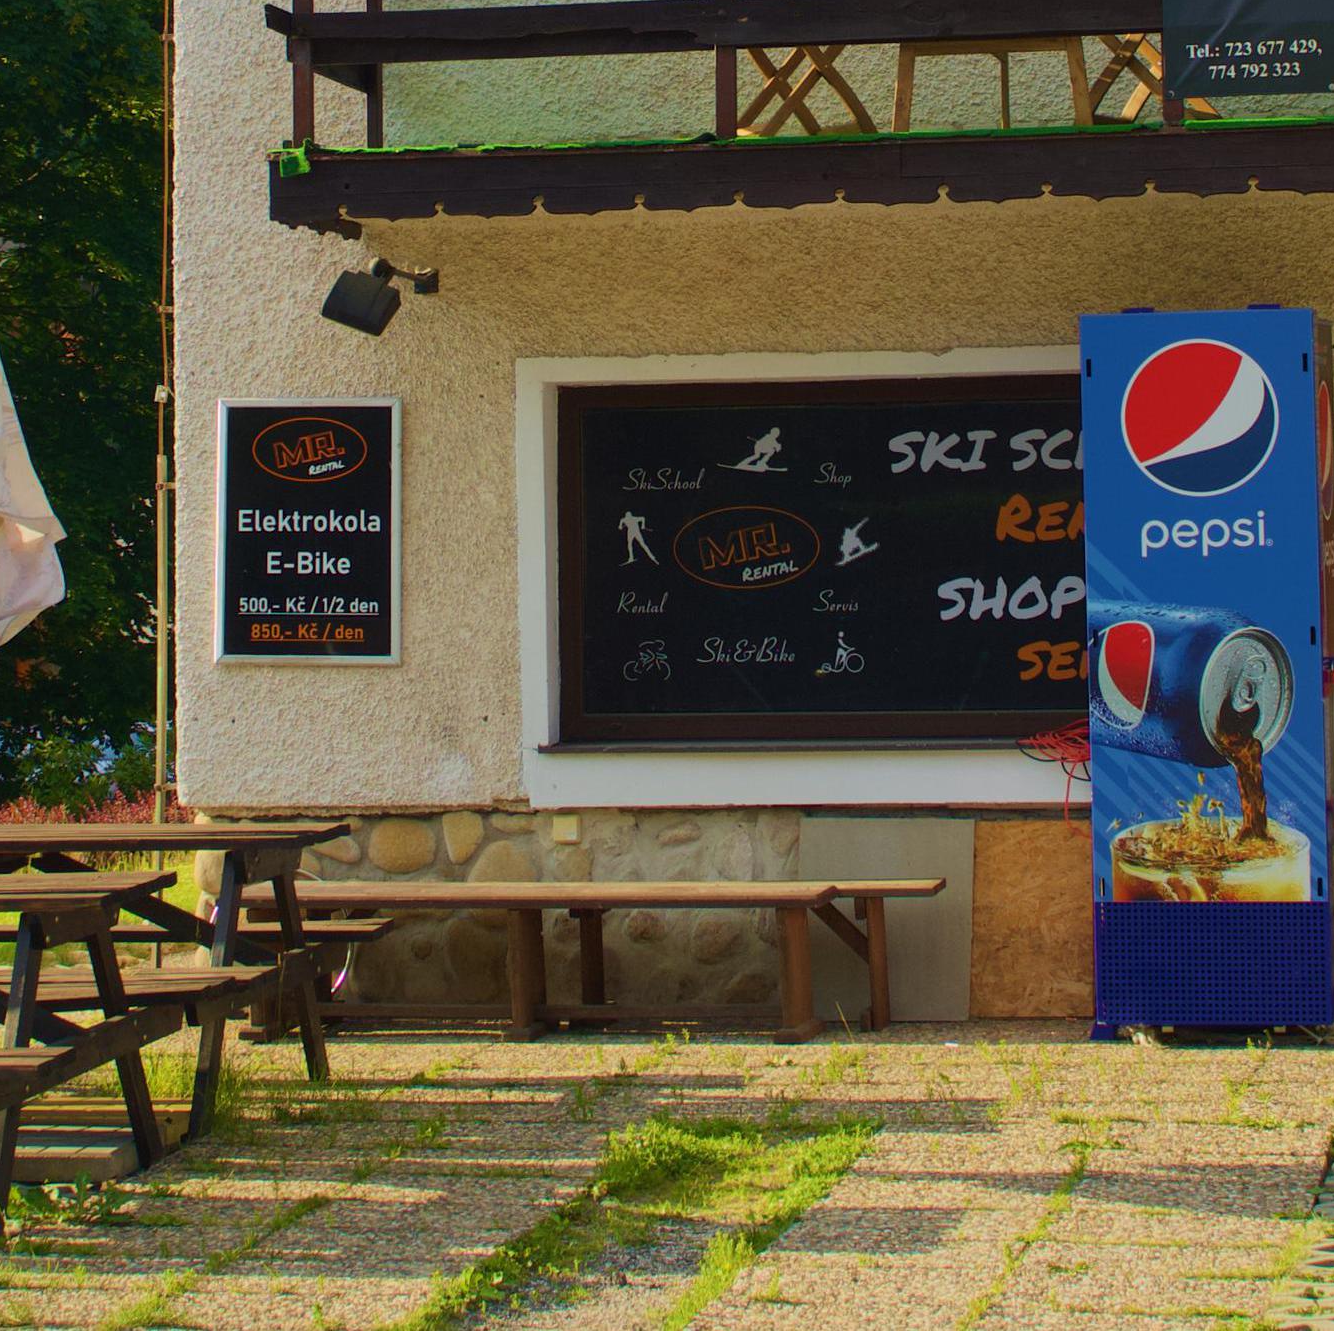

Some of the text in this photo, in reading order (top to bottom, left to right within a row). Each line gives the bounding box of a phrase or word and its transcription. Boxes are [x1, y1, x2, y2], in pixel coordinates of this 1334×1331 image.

[1186, 39, 1323, 59] Tel.: 723 677 429,
[1208, 62, 1301, 79] 774 792 323
[888, 430, 997, 474] SKI
[308, 461, 345, 475] RENTAL
[813, 462, 852, 488] Shop
[238, 509, 381, 533] Elektrokola
[1141, 510, 1265, 558] pepsi
[267, 551, 351, 575] E-Bike
[742, 560, 799, 582] RENTAL
[286, 596, 306, 613] Kč
[322, 596, 344, 614] 1/2
[350, 597, 379, 613] den
[617, 589, 859, 614] Rental Servis
[937, 575, 1086, 621] SHOP
[298, 623, 318, 639] Kč
[335, 624, 364, 639] den
[1017, 640, 1088, 681] SE
